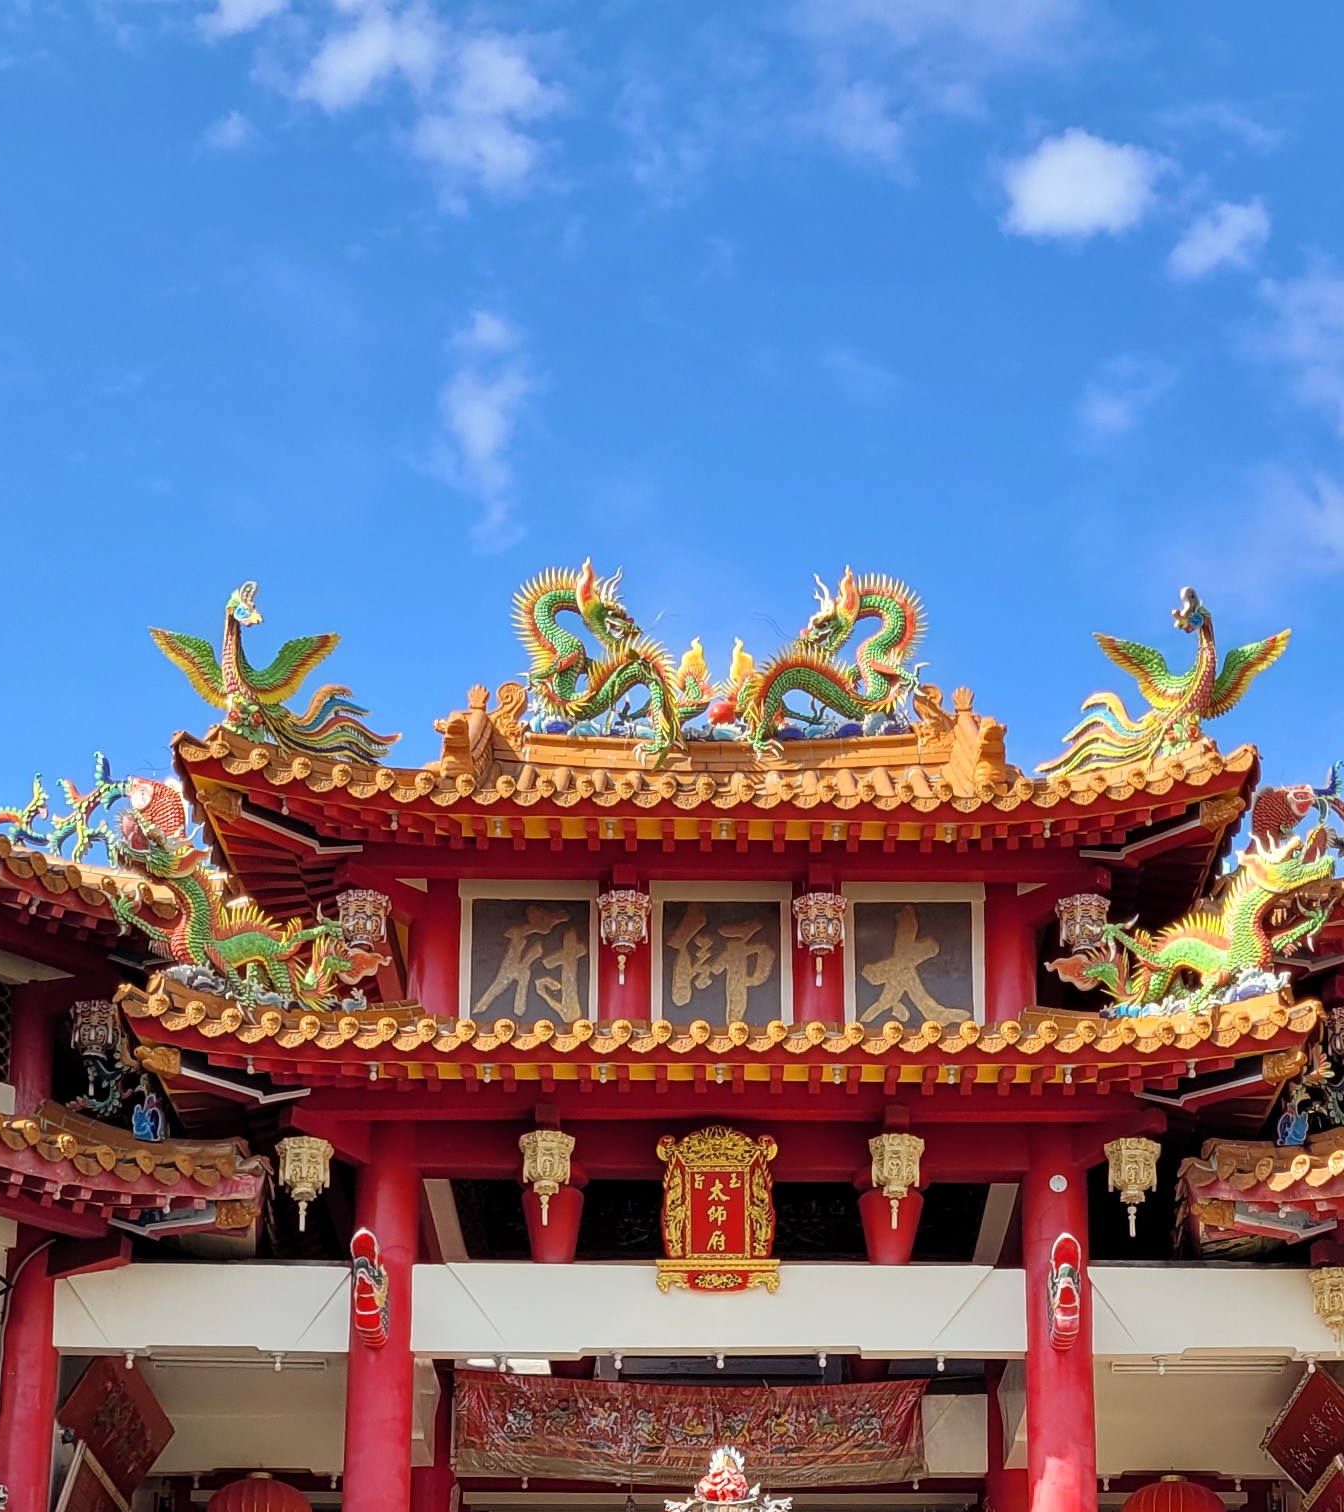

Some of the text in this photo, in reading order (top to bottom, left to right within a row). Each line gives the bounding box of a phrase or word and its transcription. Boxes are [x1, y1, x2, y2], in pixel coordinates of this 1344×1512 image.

[473, 904, 971, 1025] 太師府
[707, 1179, 730, 1251] 太師府
